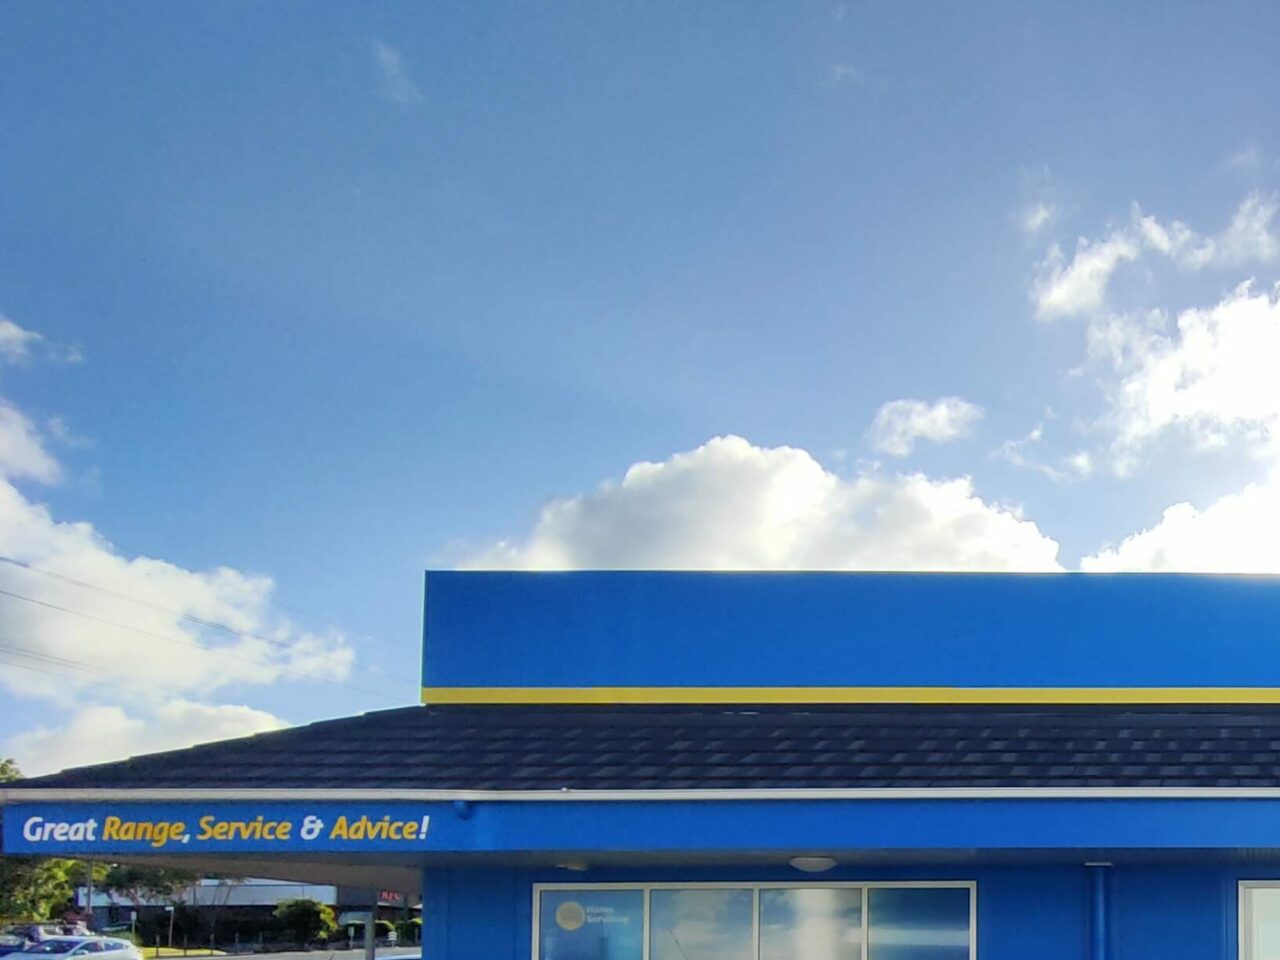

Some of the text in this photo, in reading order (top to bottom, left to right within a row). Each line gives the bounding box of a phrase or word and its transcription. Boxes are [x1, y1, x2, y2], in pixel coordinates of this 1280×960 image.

[23, 815, 430, 847] Great Range, Service & Advice!
